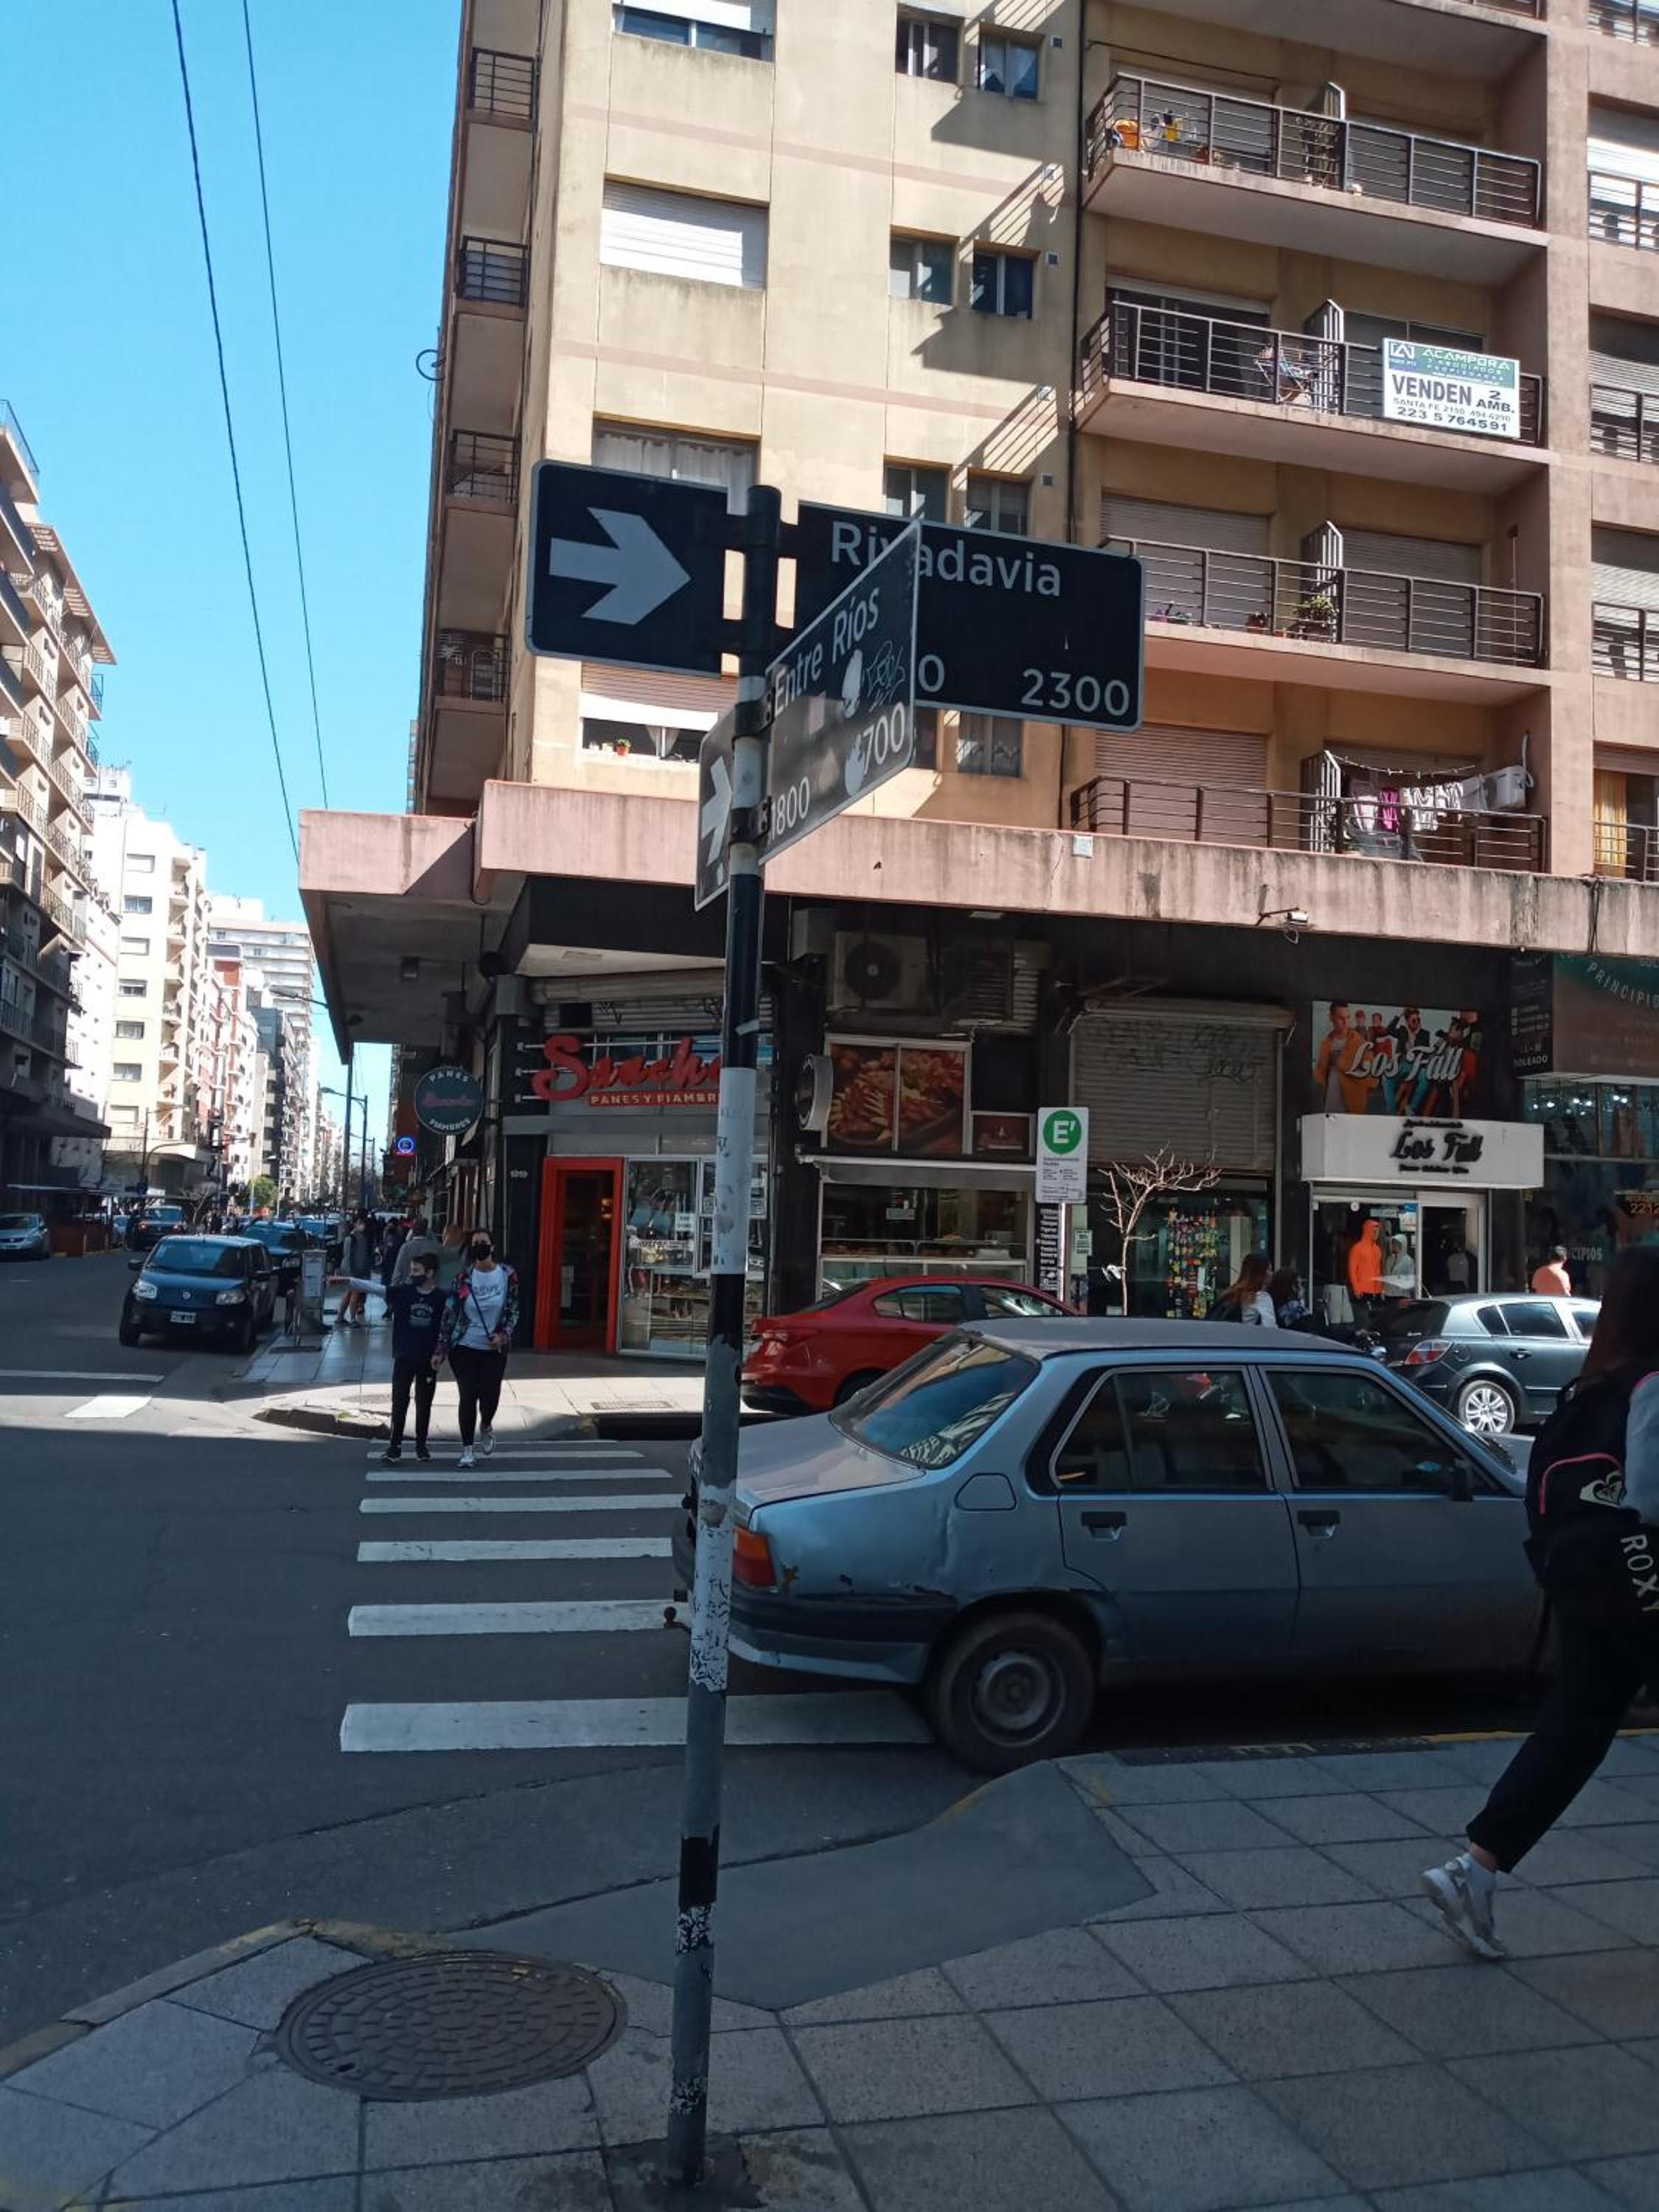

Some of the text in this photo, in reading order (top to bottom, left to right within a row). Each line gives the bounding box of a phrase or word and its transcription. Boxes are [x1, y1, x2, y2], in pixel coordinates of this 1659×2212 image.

[1422, 349, 1511, 371] ACAMPORA
[1391, 374, 1472, 406] VENDEN
[1488, 390, 1501, 400] 2
[1397, 406, 1427, 420] 223
[1433, 411, 1443, 421] 5
[1476, 399, 1515, 414] AMB.
[775, 643, 823, 718] Entre
[832, 588, 880, 664] Ríos
[1020, 668, 1130, 716] 2300
[771, 776, 810, 840] 1800
[1345, 1041, 1464, 1082] Los Fall
[591, 1092, 720, 1105] PANES Y FIAMBR
[1390, 1130, 1435, 1160] Los
